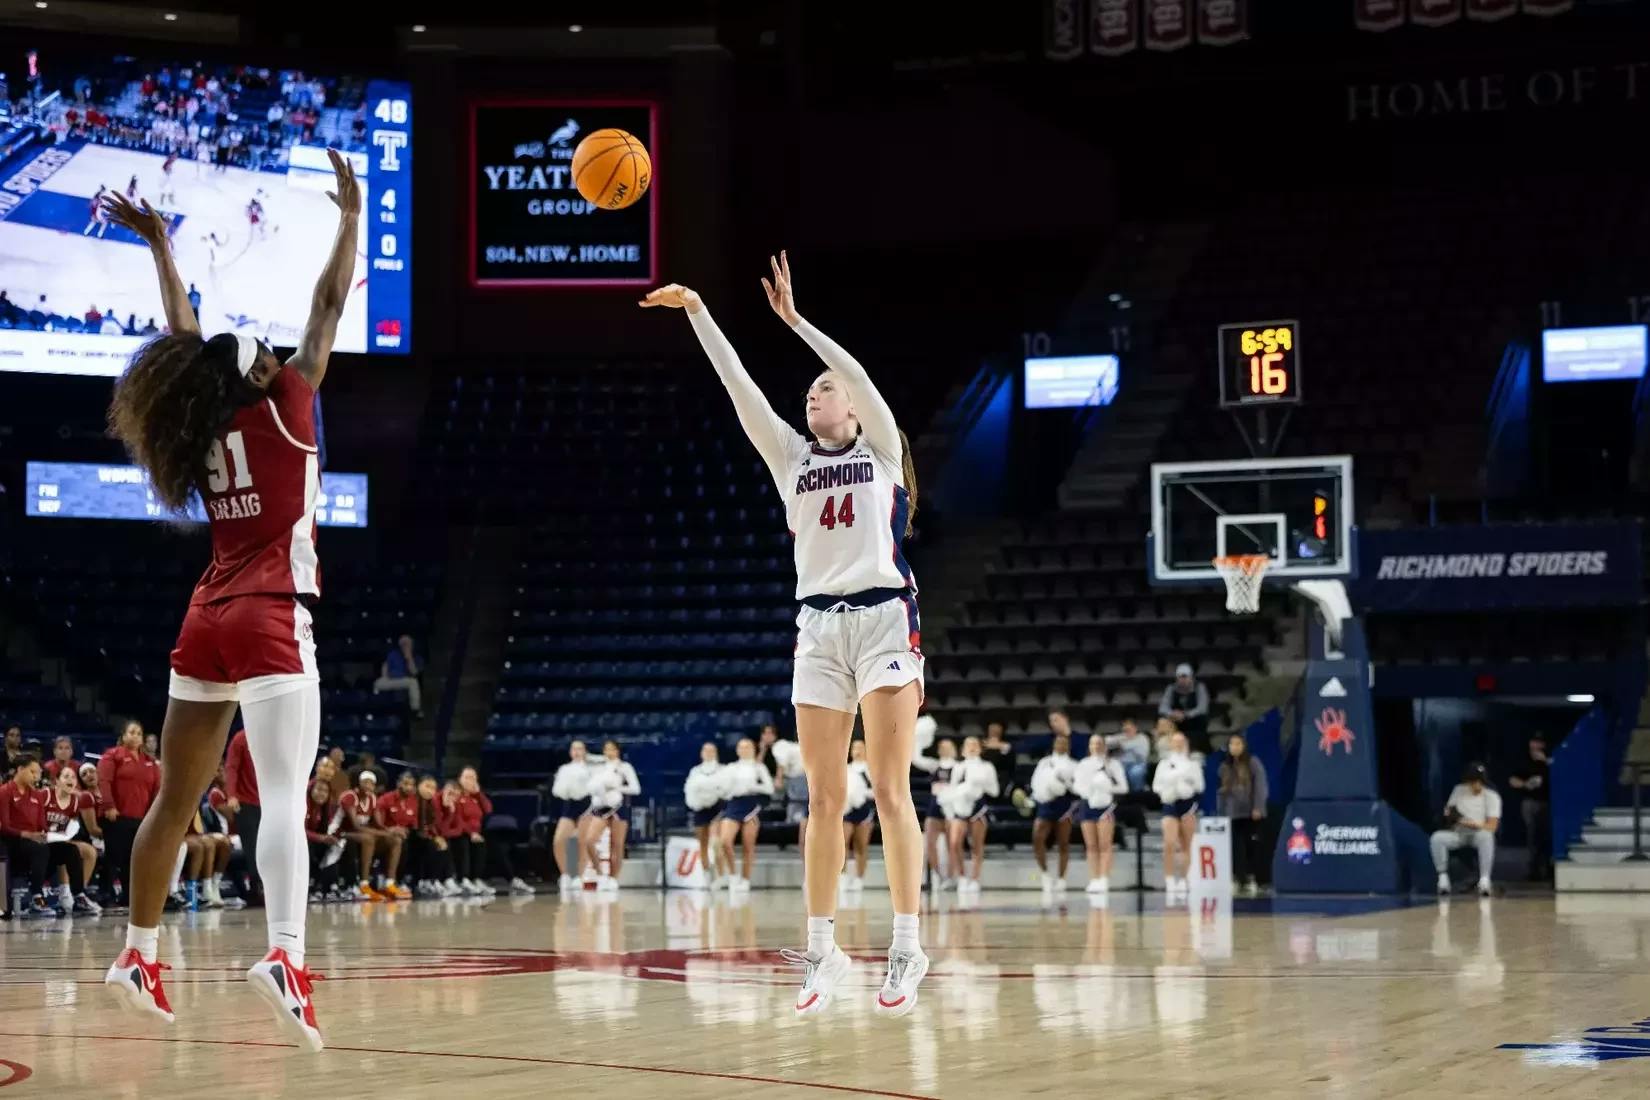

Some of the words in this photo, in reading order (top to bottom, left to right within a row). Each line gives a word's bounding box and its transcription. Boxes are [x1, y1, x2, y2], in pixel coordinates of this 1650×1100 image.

[1346, 74, 1508, 122] HOME
[1527, 66, 1598, 106] OF
[381, 189, 396, 210] 4
[528, 199, 598, 216] GROUP
[381, 234, 397, 256] 0
[484, 244, 641, 264] 804.NEW.HOME
[1022, 331, 1051, 357] 10
[1241, 327, 1292, 356] 6:59
[1250, 352, 1287, 395] 16
[205, 431, 254, 494] 91
[796, 462, 875, 496] RCHMOND
[819, 492, 855, 531] 44
[1377, 555, 1506, 580] RICHMOND
[1507, 550, 1608, 577] SPIDERS
[1315, 823, 1380, 841] SHERWIN
[1199, 845, 1217, 879] R
